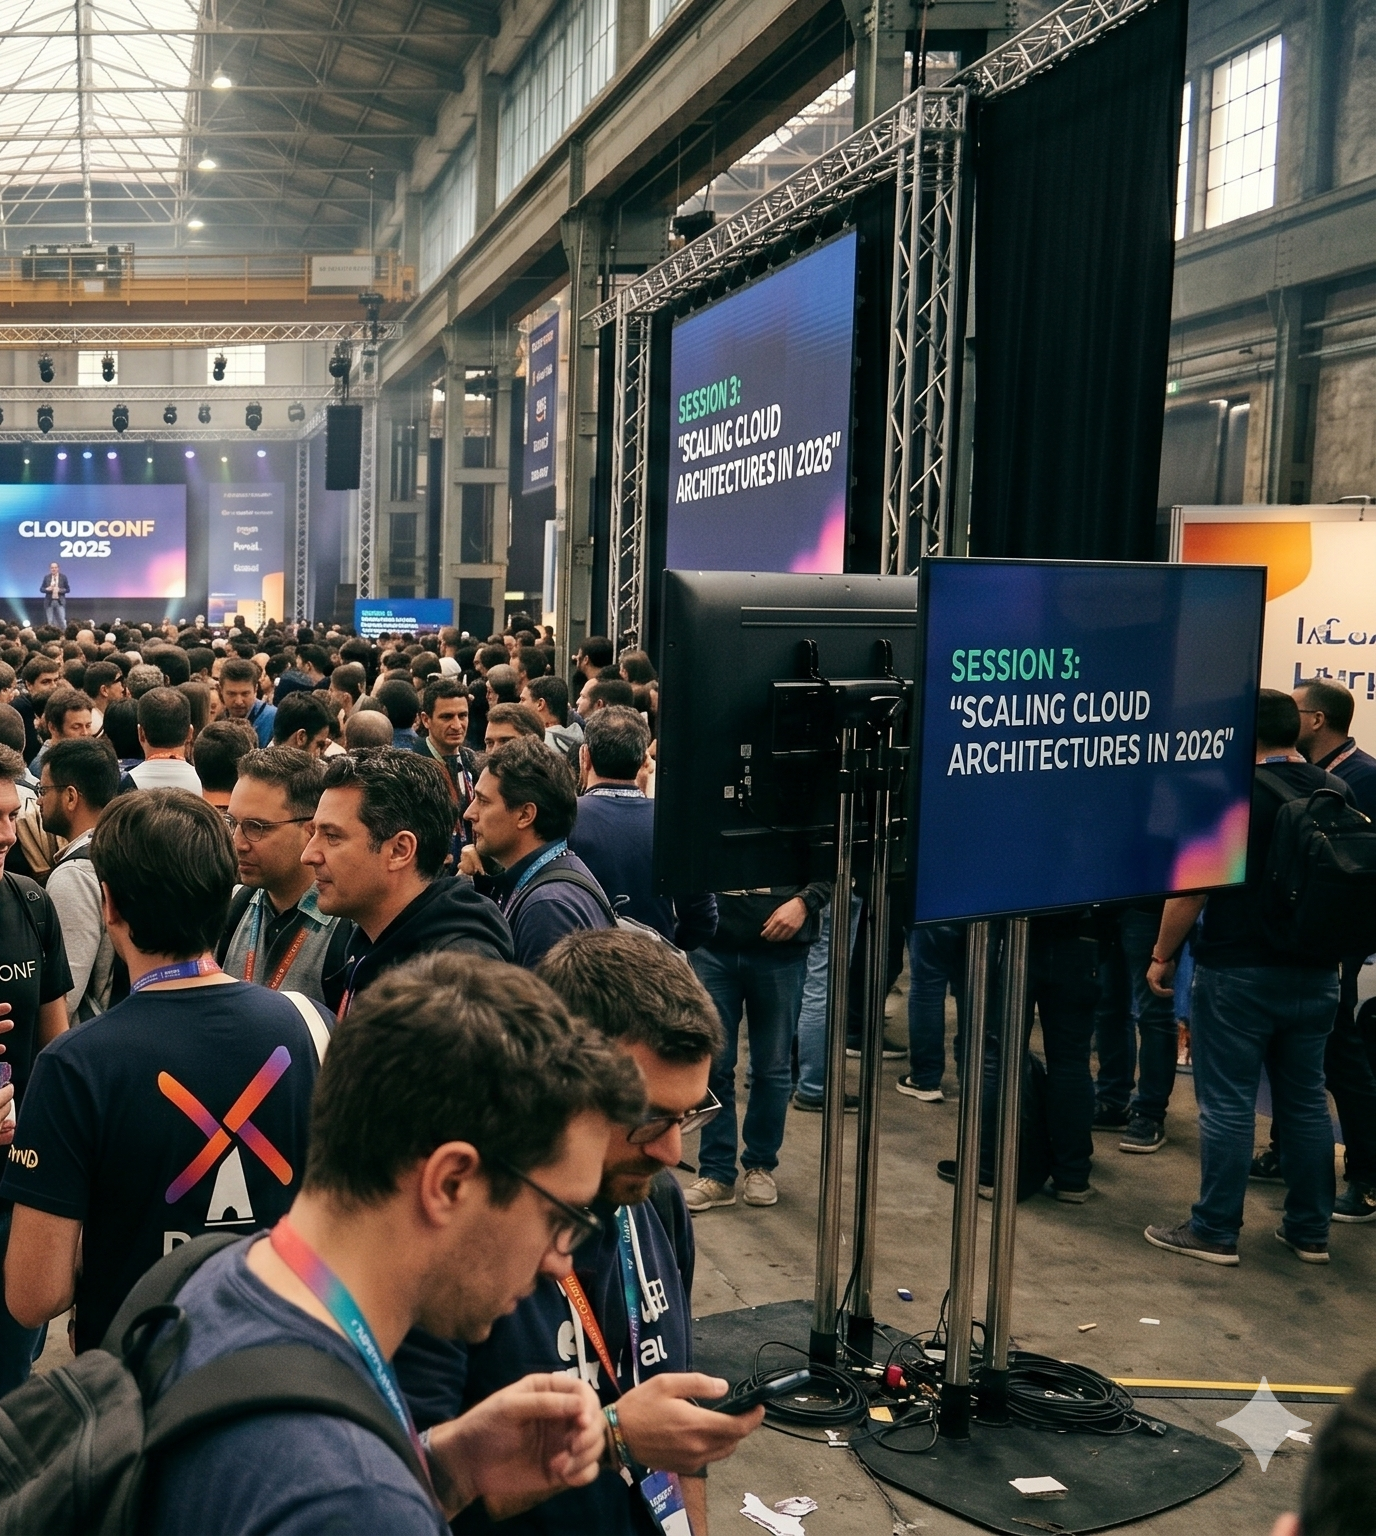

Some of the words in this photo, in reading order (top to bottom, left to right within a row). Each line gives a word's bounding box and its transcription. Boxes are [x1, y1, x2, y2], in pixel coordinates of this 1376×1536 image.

[678, 378, 728, 424] SESSION
[729, 375, 742, 407] 3:
[678, 419, 734, 463] "SCALING
[735, 403, 782, 448] CLOUD
[675, 449, 776, 504] ARCHITECTURES
[777, 444, 794, 482] IN
[18, 520, 155, 538] CLOUDCONF
[59, 540, 112, 558] 2025
[951, 648, 1054, 682] SESSION
[1060, 648, 1080, 680] 3:
[949, 693, 1066, 728] “SCALING
[1073, 690, 1151, 723] CLOUD
[946, 733, 1141, 776] ARCHITECTURES
[1147, 732, 1170, 763] IN
[1174, 727, 1235, 762] 2026”
